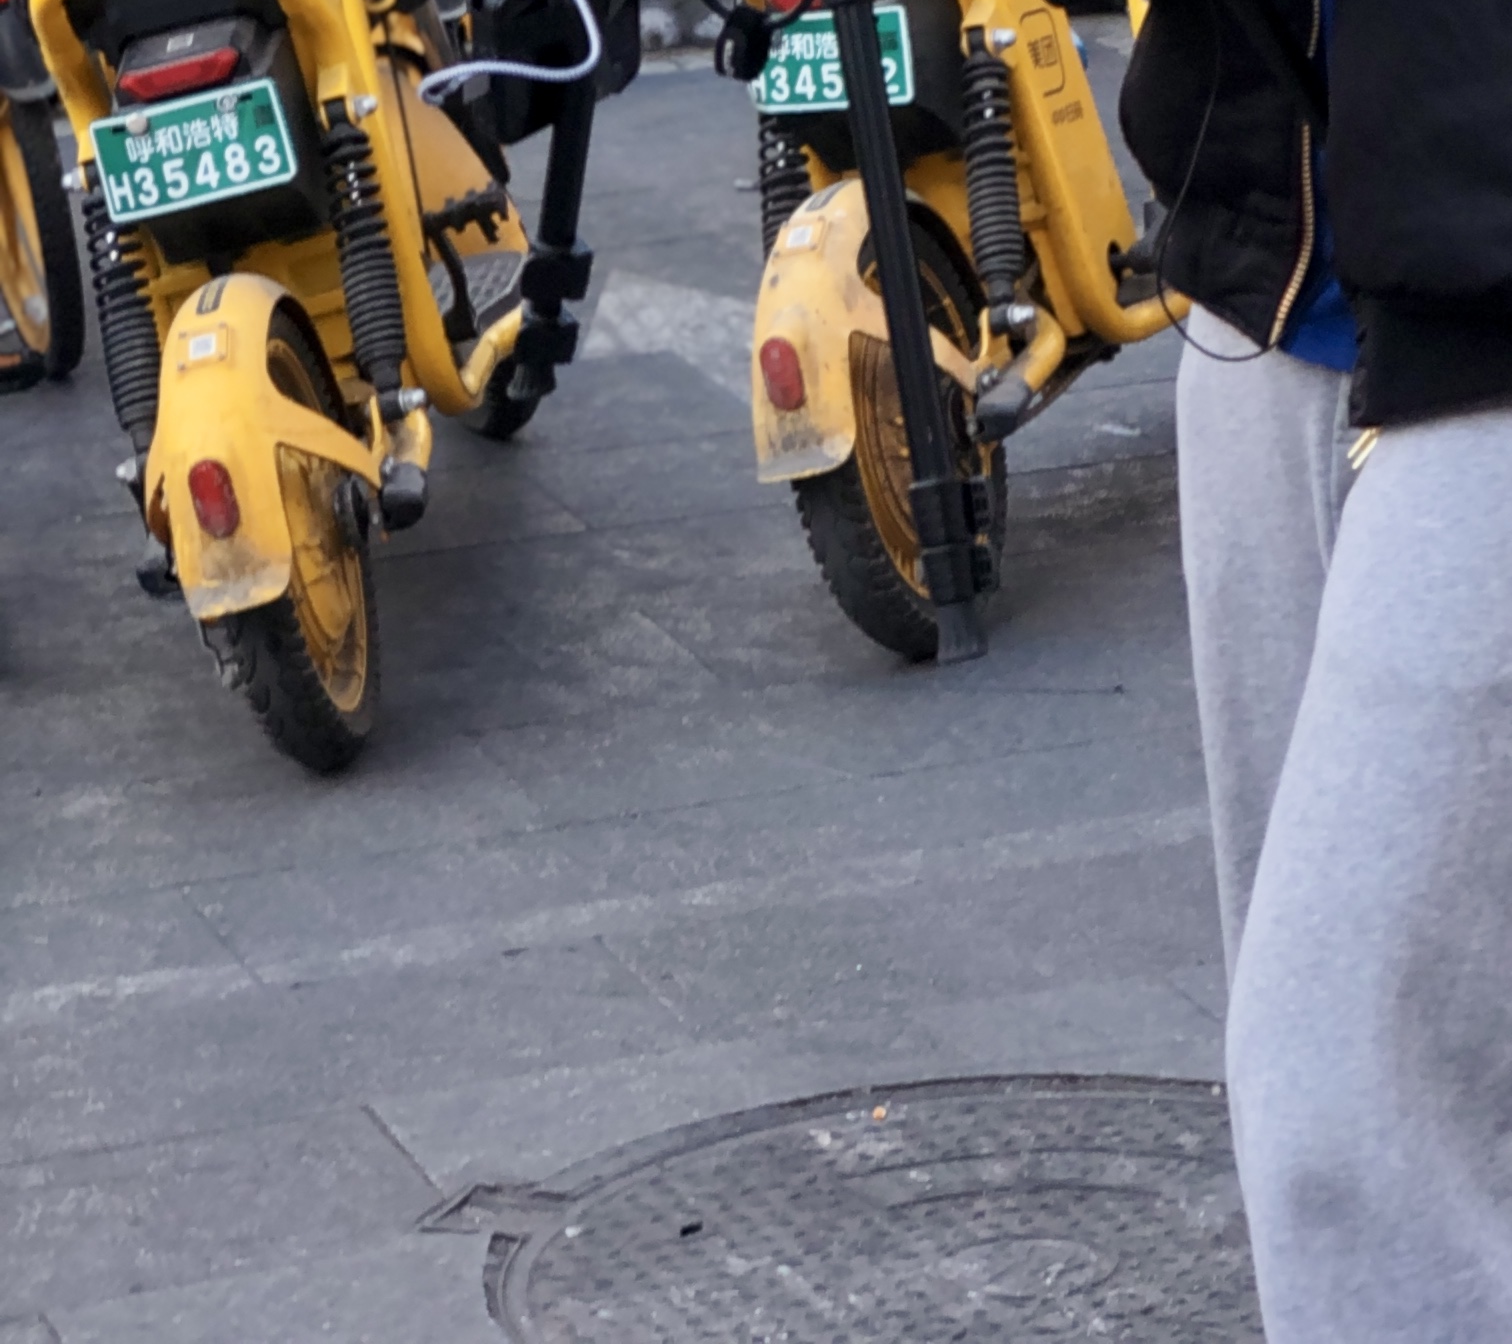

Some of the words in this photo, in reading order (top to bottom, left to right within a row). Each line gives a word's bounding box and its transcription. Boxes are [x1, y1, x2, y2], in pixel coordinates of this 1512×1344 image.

[768, 31, 839, 62] 呼和浩
[1027, 33, 1058, 70] 美团
[751, 57, 898, 104] H3452
[124, 110, 240, 164] 呼和浩特
[108, 134, 282, 213] H35483
